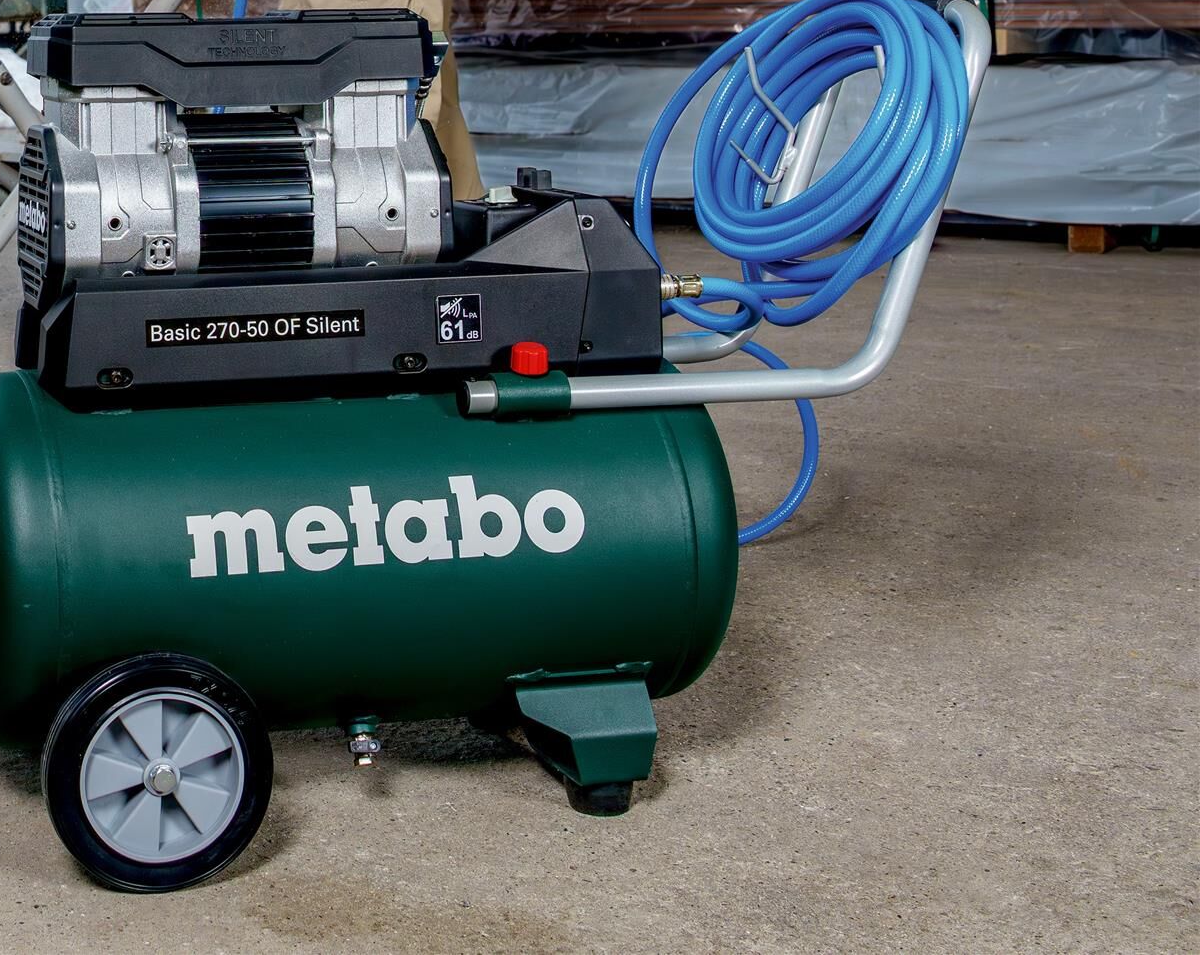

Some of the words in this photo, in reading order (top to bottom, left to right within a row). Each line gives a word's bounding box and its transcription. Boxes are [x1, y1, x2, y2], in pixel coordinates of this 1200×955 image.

[219, 28, 275, 44] SILENT
[208, 46, 286, 58] TECHNOLOGY
[19, 200, 46, 234] metabo
[150, 324, 201, 342] Basic
[206, 320, 269, 339] 270-50
[274, 317, 301, 336] OF
[306, 316, 360, 334] Silent
[440, 319, 464, 341] 61
[466, 330, 479, 339] dB
[186, 475, 585, 578] metabo
